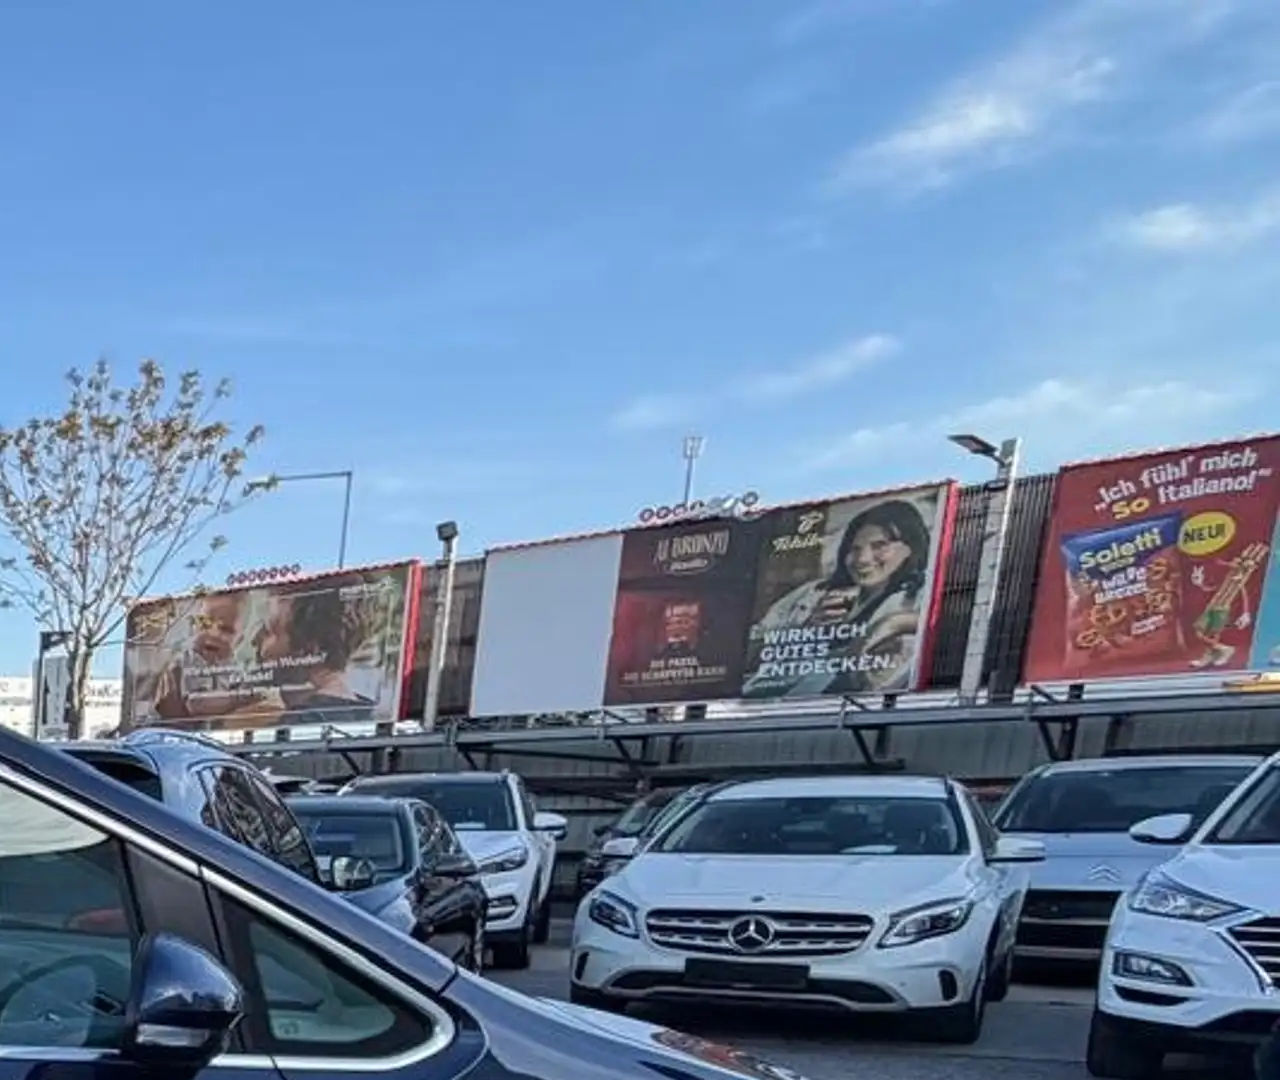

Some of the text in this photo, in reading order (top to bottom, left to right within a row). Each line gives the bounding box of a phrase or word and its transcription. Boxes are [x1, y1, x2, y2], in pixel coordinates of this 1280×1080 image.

[1200, 447, 1258, 473] mich
[1078, 527, 1162, 569] Soletti
[763, 623, 868, 645] WIRKLICH
[760, 643, 830, 661] GUTES
[758, 653, 897, 678] ENTDECKEN.
